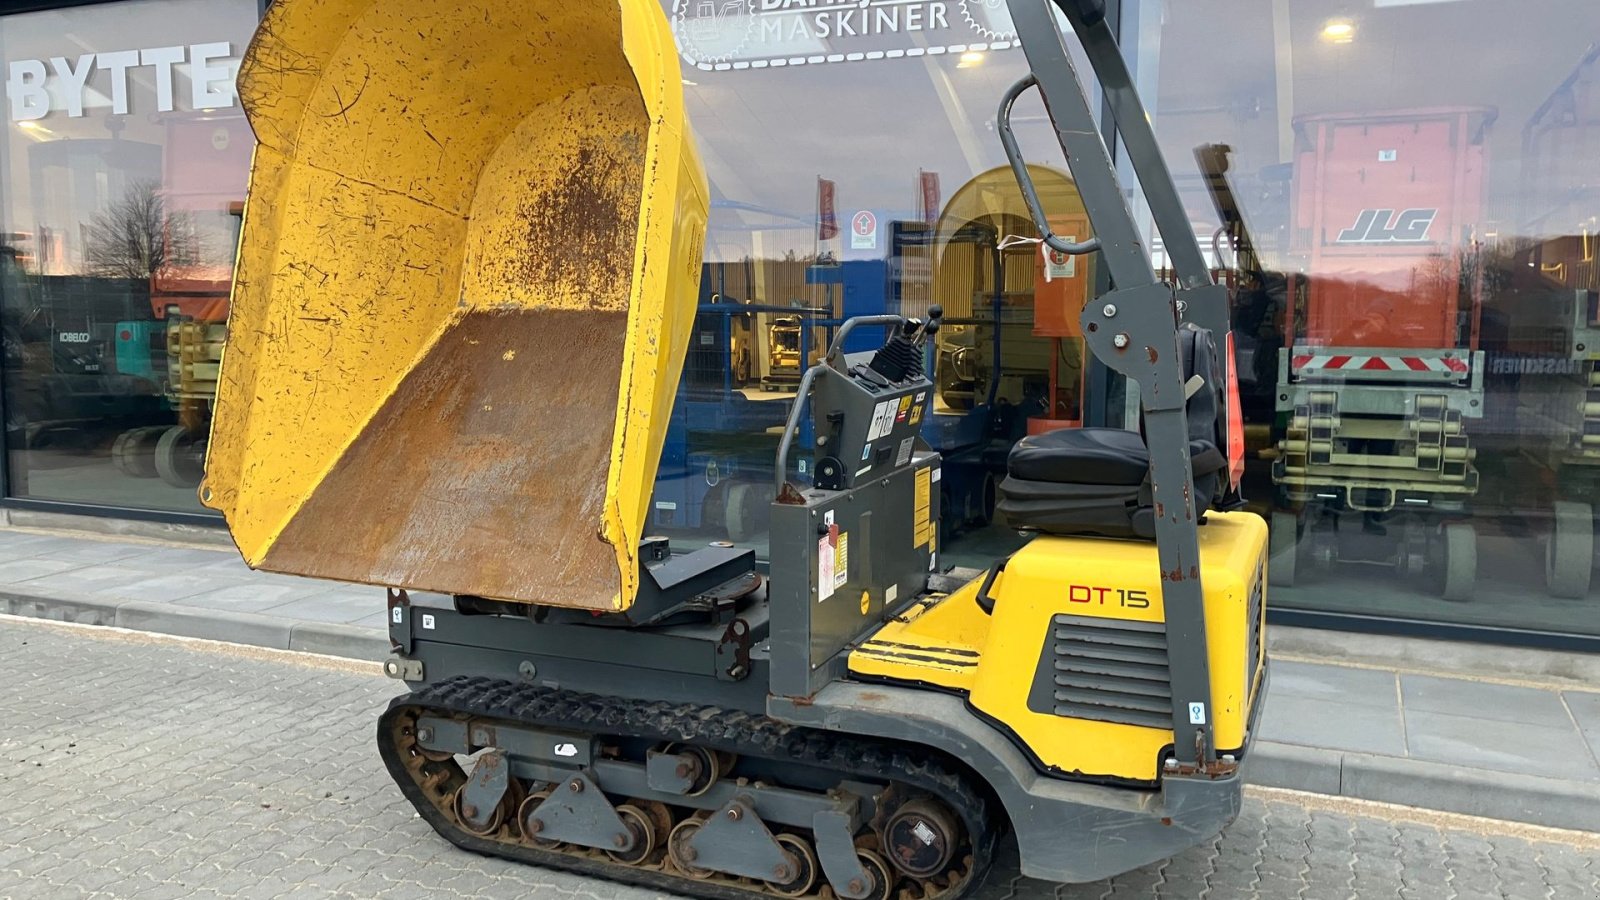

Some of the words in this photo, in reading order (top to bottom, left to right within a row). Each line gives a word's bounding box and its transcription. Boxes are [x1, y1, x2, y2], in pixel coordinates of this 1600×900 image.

[760, 2, 949, 42] MASKINER
[9, 41, 234, 121] BYTTE
[1336, 208, 1438, 242] JLG
[60, 332, 90, 342] KOBELCO
